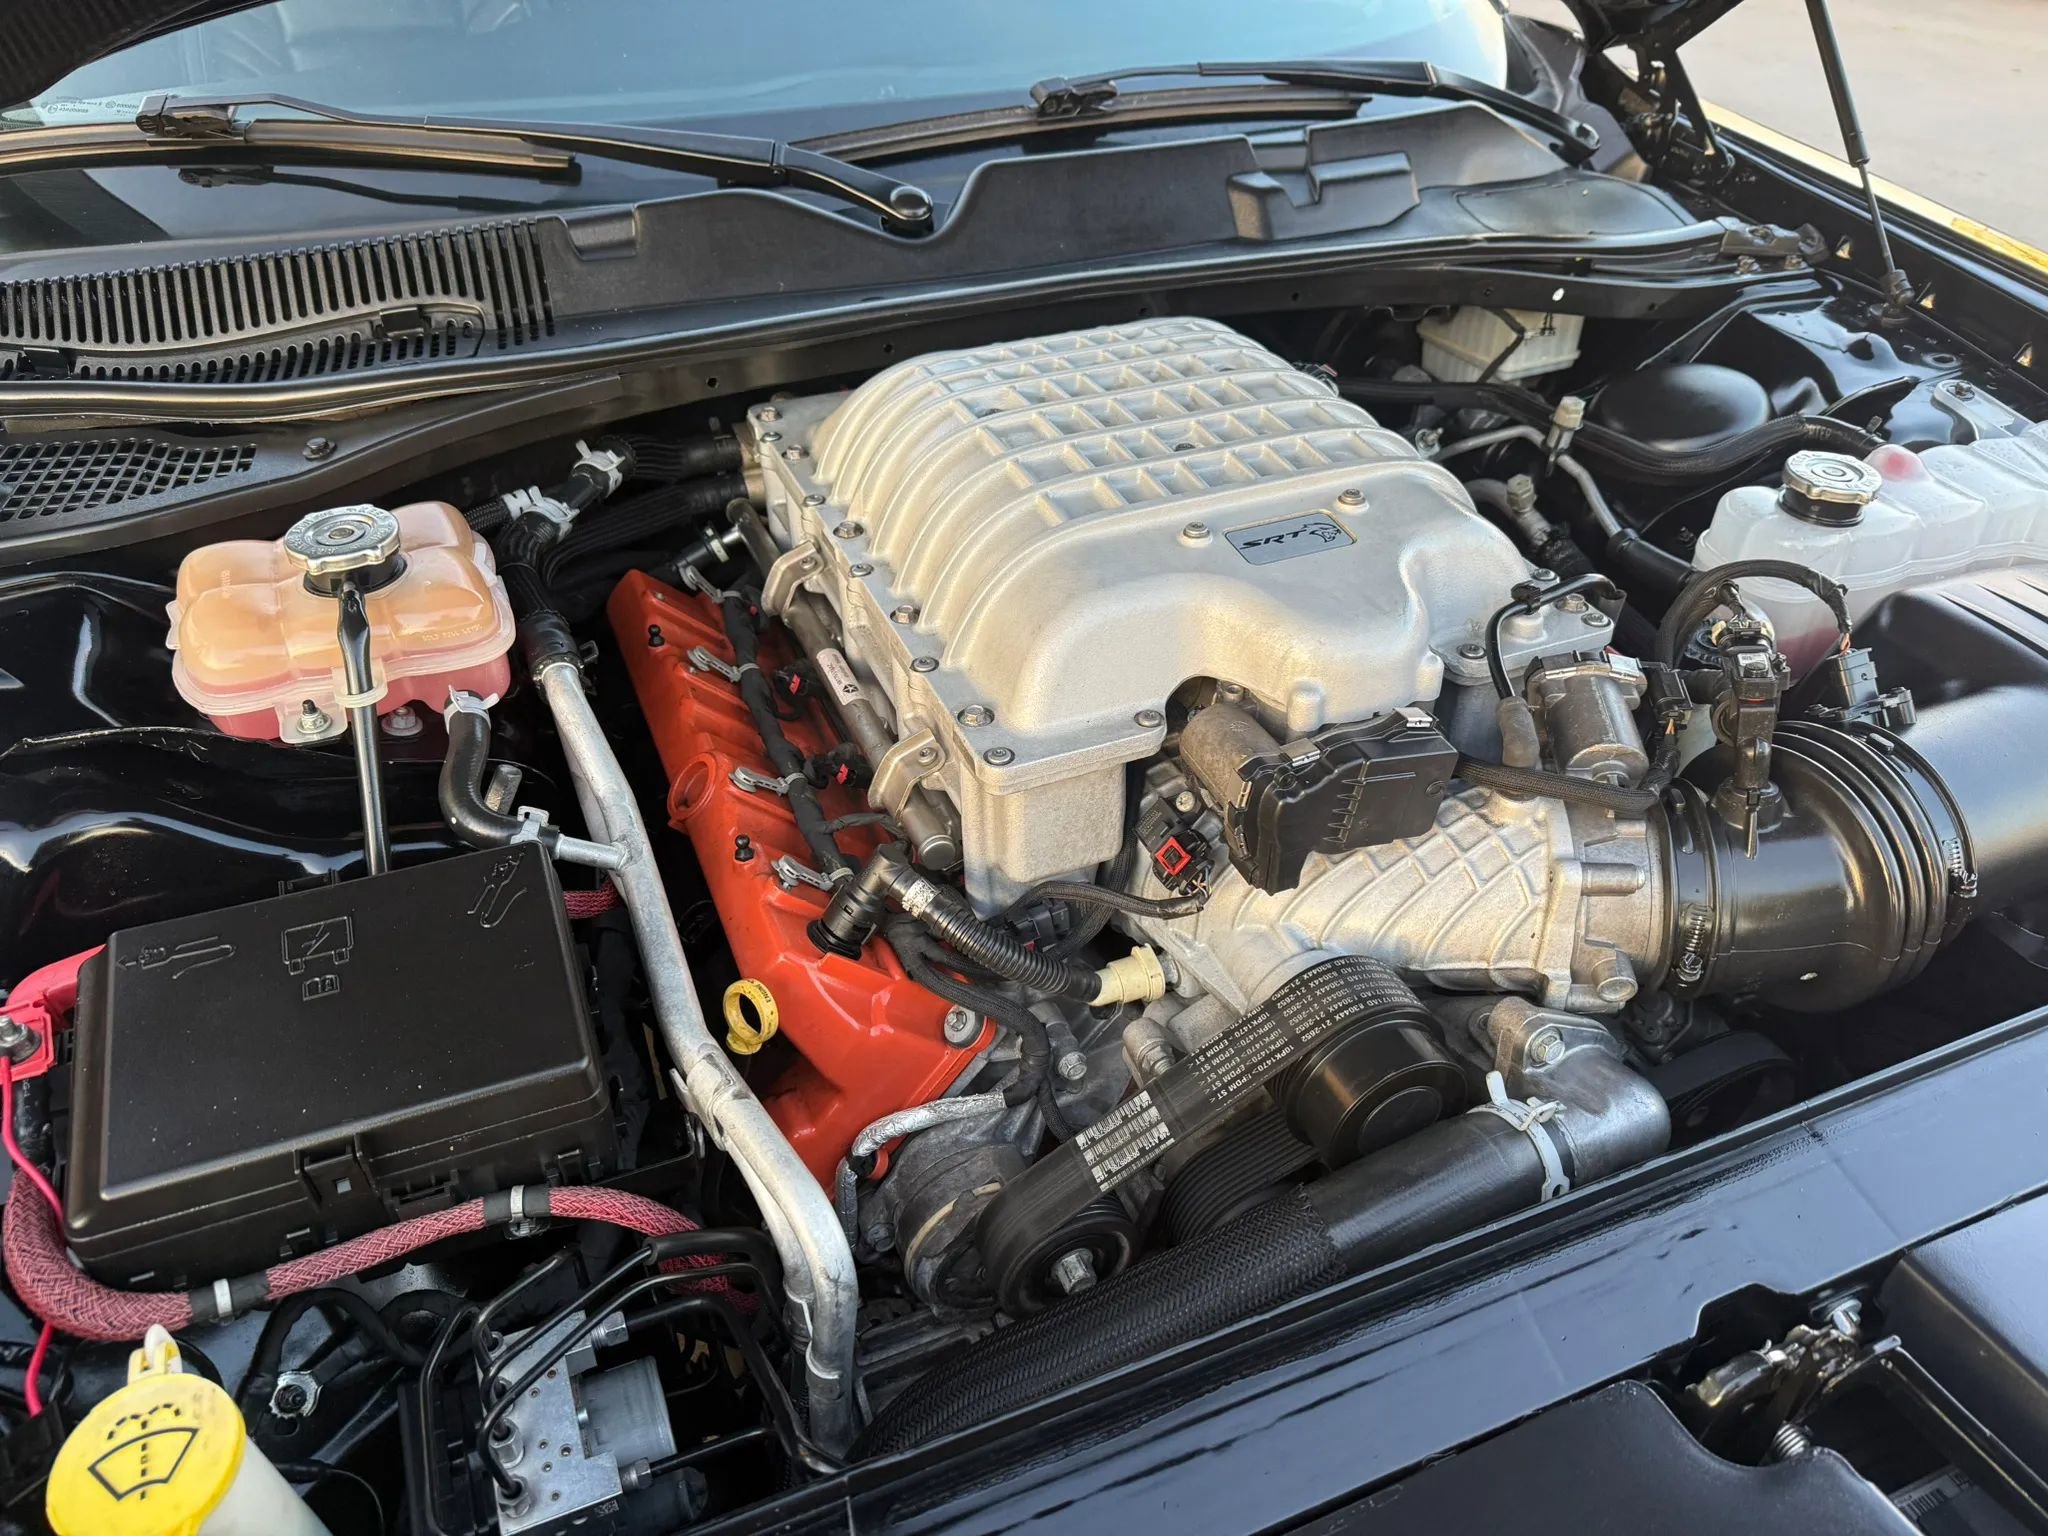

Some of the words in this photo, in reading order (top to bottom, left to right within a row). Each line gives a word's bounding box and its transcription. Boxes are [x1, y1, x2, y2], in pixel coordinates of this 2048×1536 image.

[1240, 529, 1308, 550] SRT
[1275, 986, 1306, 1009] 21-2652
[1281, 994, 1312, 1017] 21-2652
[1294, 1010, 1325, 1034] 21-2652
[1300, 1018, 1332, 1042] 21-2652
[1205, 1038, 1228, 1057] EPDM
